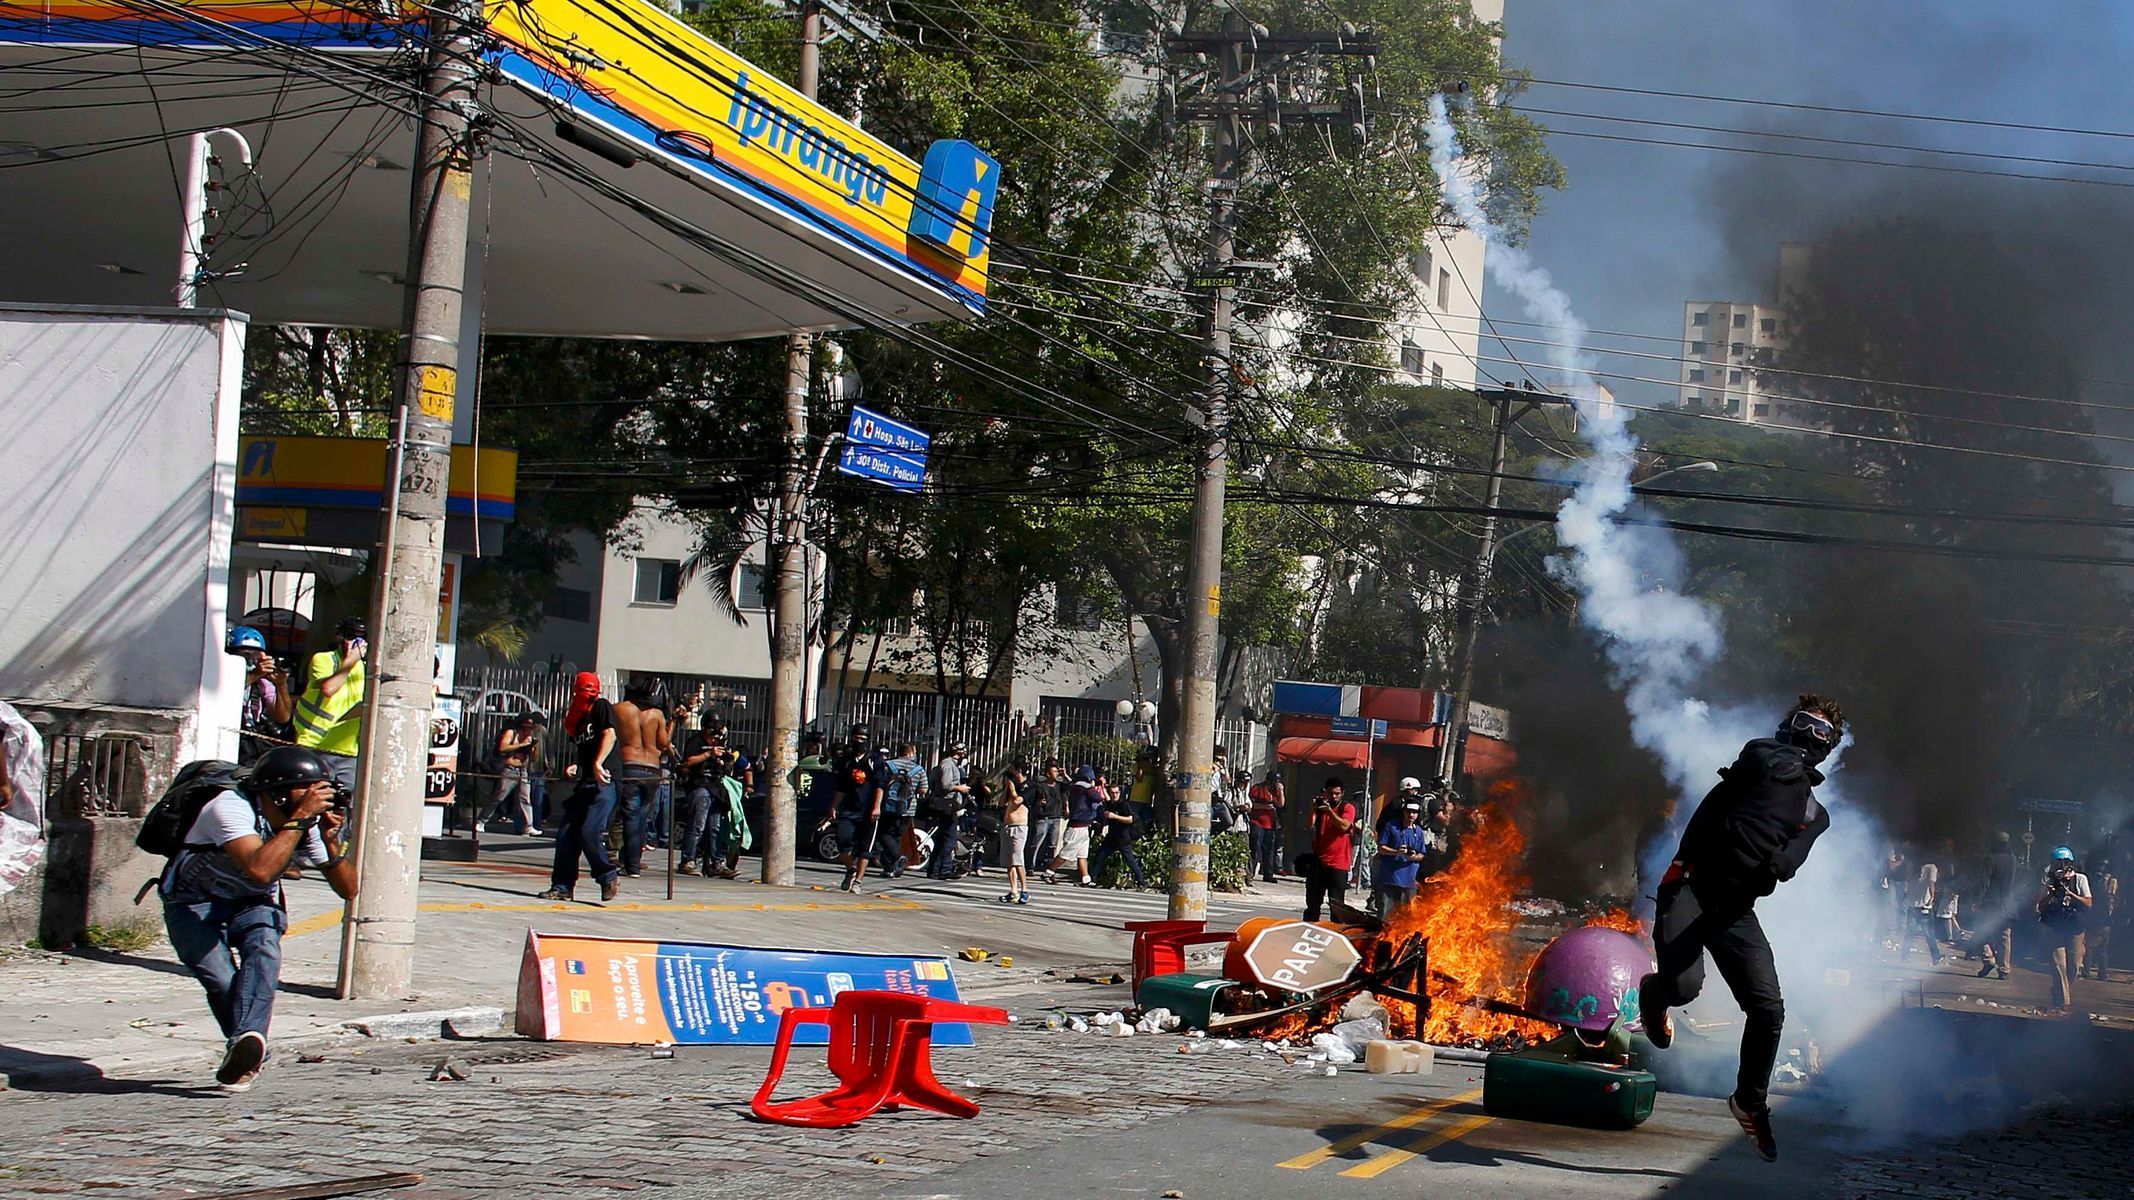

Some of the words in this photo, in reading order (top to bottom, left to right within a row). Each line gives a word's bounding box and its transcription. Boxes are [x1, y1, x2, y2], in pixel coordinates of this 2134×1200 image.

[728, 71, 889, 207] Ipiranga
[874, 427, 895, 445] Hosp.
[872, 459, 891, 475] Distr.
[893, 467, 919, 482] Policial
[1271, 928, 1334, 987] PARE
[607, 959, 622, 983] faça
[726, 971, 736, 982] DE
[614, 985, 623, 993] o
[623, 956, 646, 1014] Aproveite
[635, 1016, 647, 1024] e
[664, 959, 684, 1028] www.ipiranga.com.br
[615, 996, 628, 1021] seu.
[730, 983, 745, 1022] DESCONTO
